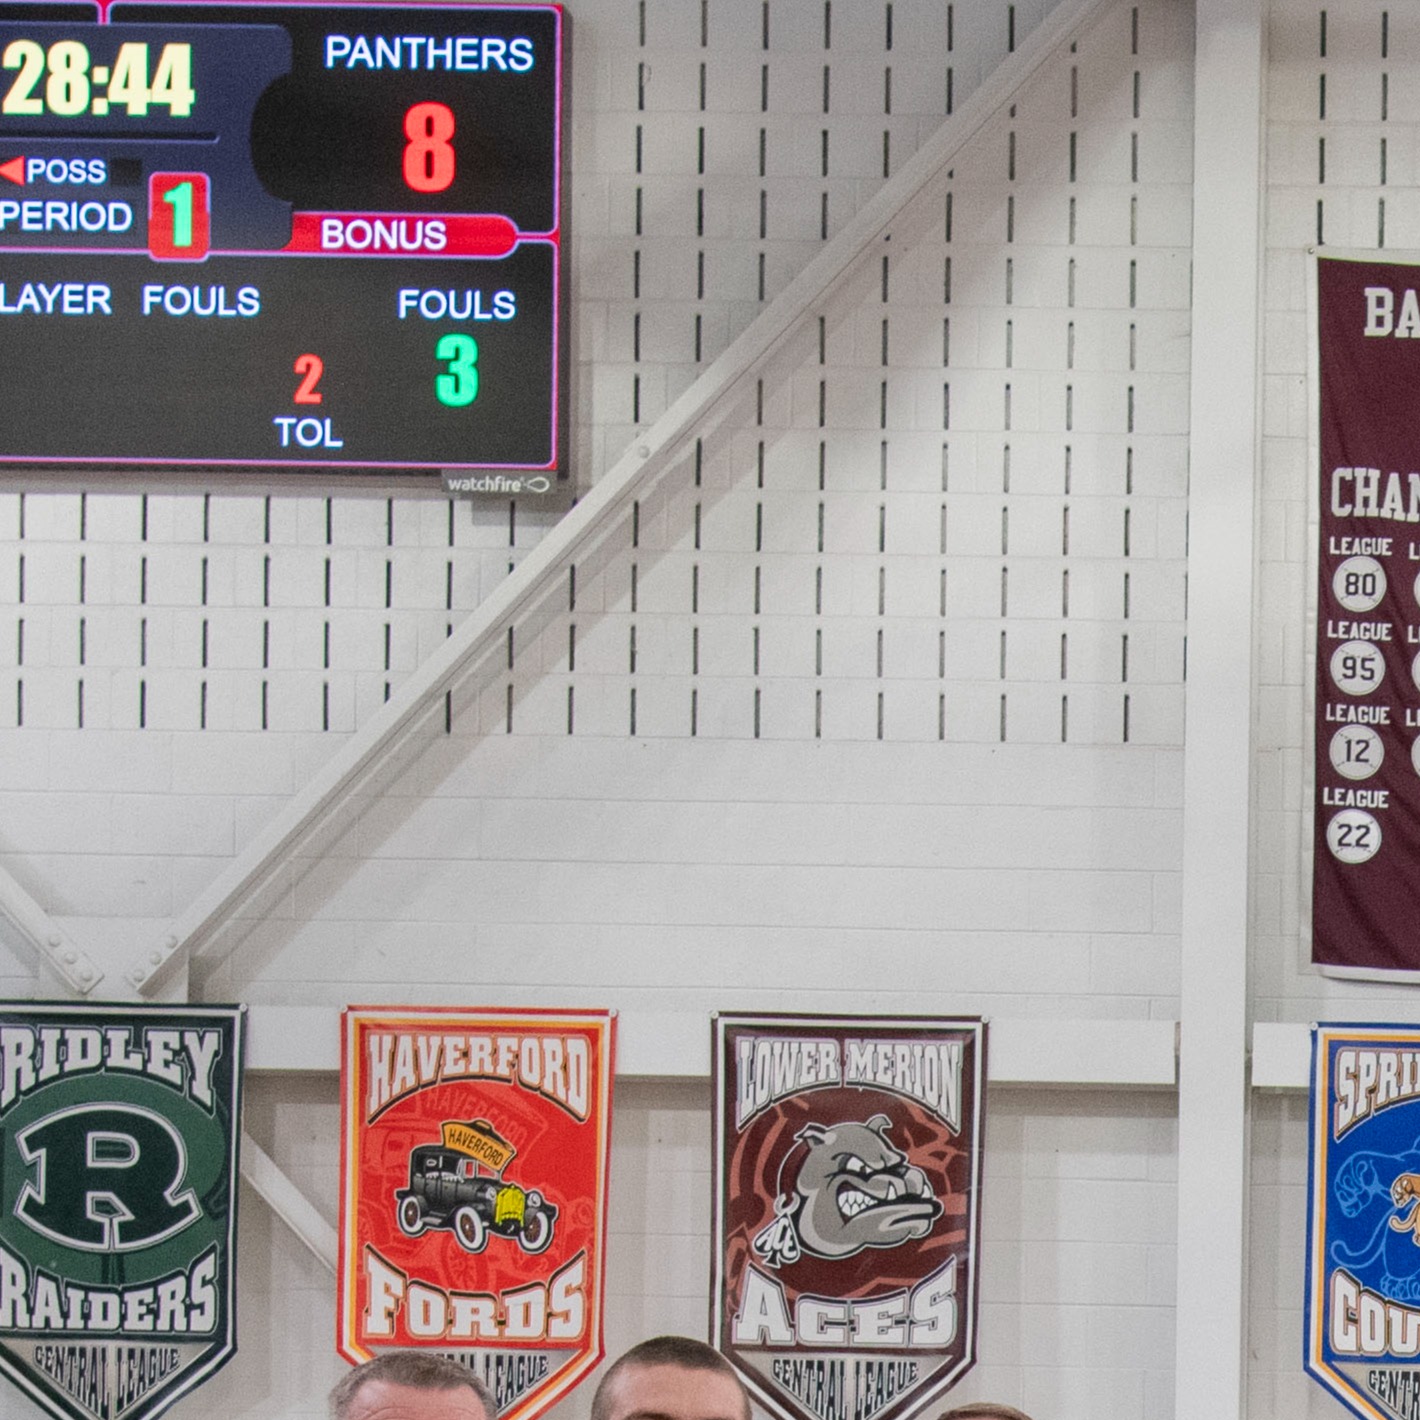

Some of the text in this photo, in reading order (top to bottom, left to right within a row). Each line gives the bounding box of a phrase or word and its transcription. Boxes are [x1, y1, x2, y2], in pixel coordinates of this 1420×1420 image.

[2, 40, 195, 117] 28:44
[324, 36, 534, 71] PANTHERS
[27, 159, 106, 183] POSS
[402, 101, 457, 193] 8
[0, 182, 193, 247] PERIOD 1
[321, 220, 447, 250] BONUS
[0, 284, 260, 316] LAYER FOULS
[398, 290, 516, 320] FOULS
[294, 354, 323, 404] 2
[435, 334, 479, 406] 3
[275, 419, 343, 447] TOL
[449, 475, 523, 492] watchfire
[1330, 537, 1392, 556] LEAGUE
[1345, 573, 1376, 596] 80
[1327, 621, 1392, 641] LEAGUE
[1342, 657, 1375, 681] 95
[1, 1027, 220, 1104] RIDLEY
[367, 1034, 590, 1121] HAVERFORD
[737, 1040, 962, 1134] LOWER MERION
[448, 1126, 504, 1167] HAVERFORD
[14, 1102, 202, 1251] R
[757, 1217, 799, 1257] ACE
[0, 1245, 217, 1330] RAIDERS
[365, 1246, 588, 1339] FORDS
[733, 1259, 957, 1346] ACES
[116, 1346, 180, 1418] LEAGUE
[485, 1352, 548, 1410] LEAGUE
